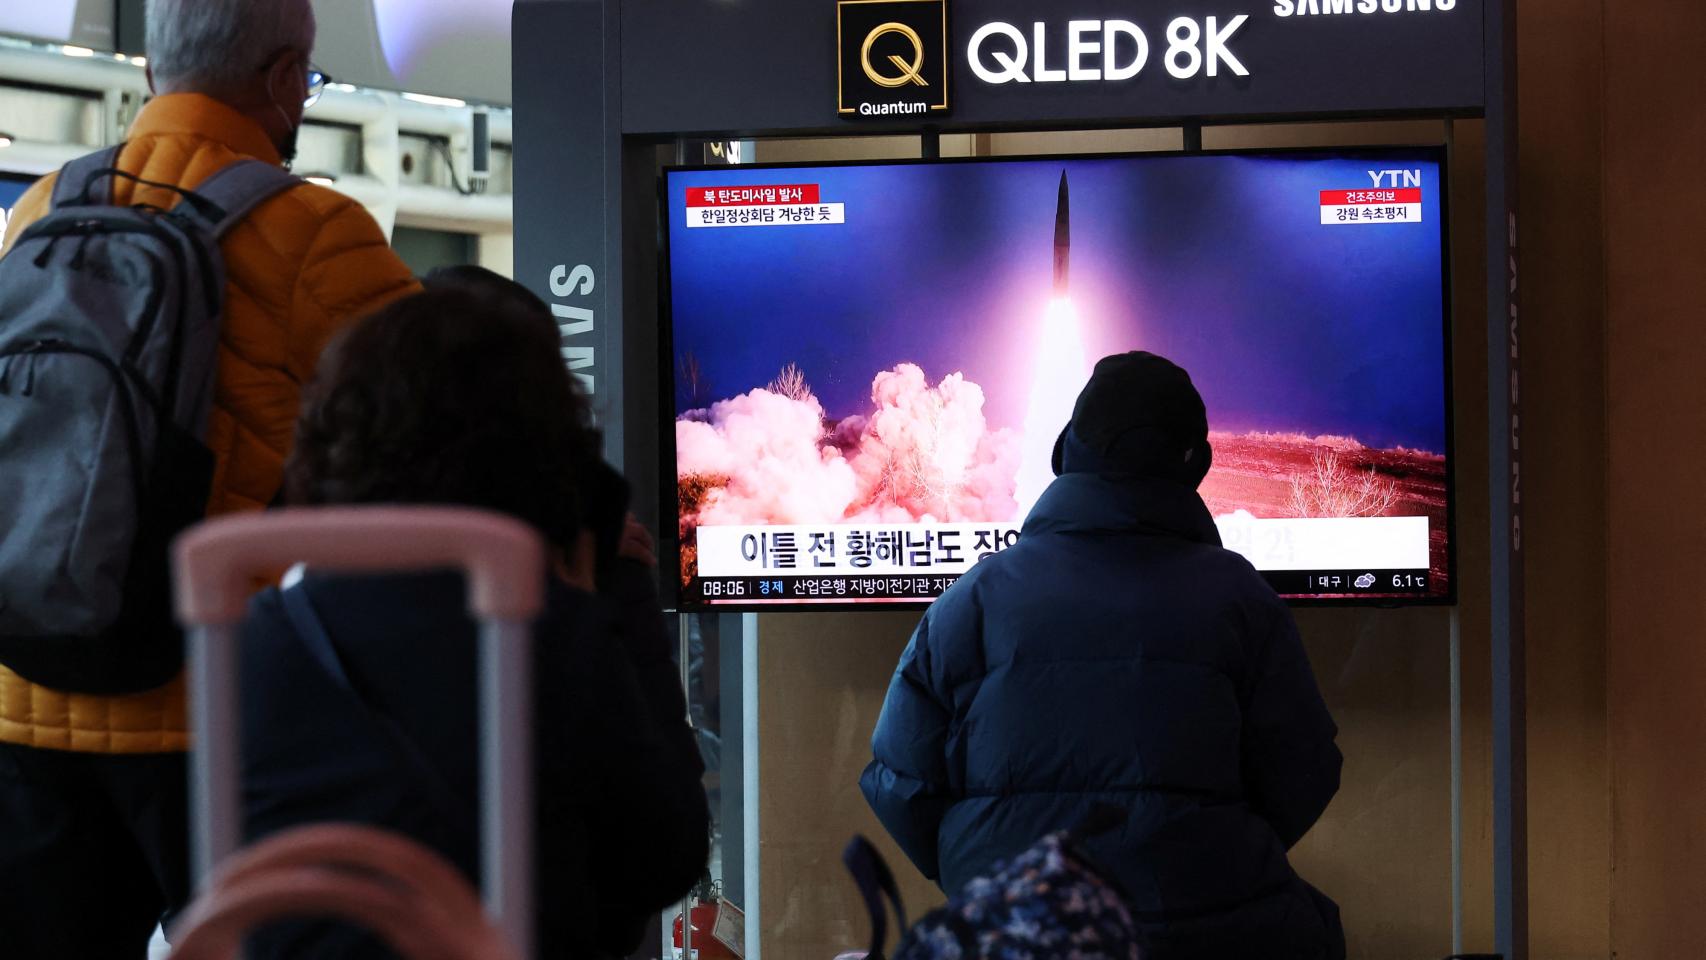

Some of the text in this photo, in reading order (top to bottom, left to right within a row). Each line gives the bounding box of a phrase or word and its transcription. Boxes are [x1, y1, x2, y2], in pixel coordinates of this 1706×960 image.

[967, 15, 1250, 84] QLED 8K
[859, 101, 927, 115] Quantum
[1368, 169, 1421, 188] YTN
[704, 188, 803, 203] 북 탄도미사일 발사
[1346, 191, 1396, 203] 건조주의보
[701, 206, 831, 224] 한일정상회담 겨냥한 듯
[1336, 206, 1407, 221] 강원 속초평지
[1509, 211, 1520, 551] SAMSUNG
[741, 531, 798, 569] 이틀
[807, 531, 836, 567] 전
[846, 529, 964, 568] 황해남도
[703, 581, 745, 596] 08:06
[759, 579, 784, 595] 경제
[793, 578, 846, 596] 산업은행
[850, 578, 930, 595] 지방이전기관
[1318, 575, 1342, 588] 대구
